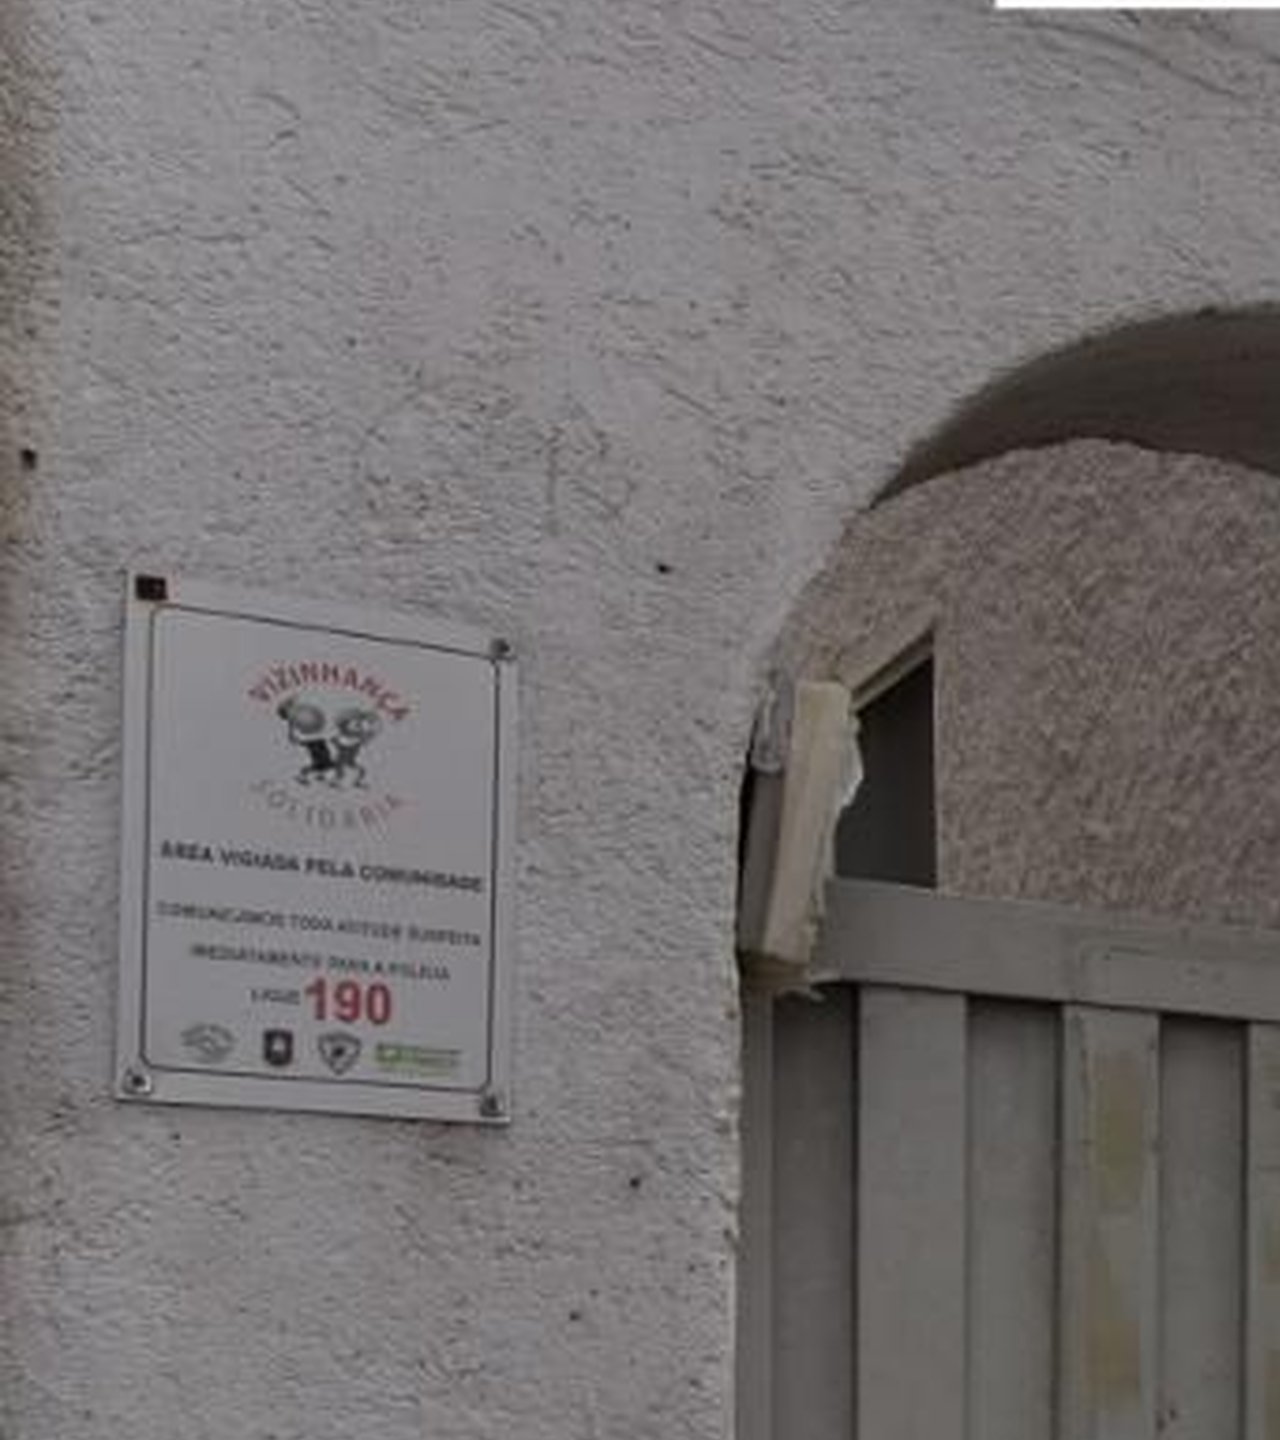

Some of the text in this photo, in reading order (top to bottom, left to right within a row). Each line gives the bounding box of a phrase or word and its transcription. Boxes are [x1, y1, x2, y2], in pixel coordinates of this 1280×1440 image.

[219, 848, 300, 871] VIGIADA
[305, 857, 354, 878] PELA
[360, 864, 482, 892] COMUNIDADE
[304, 976, 392, 1025] 190
